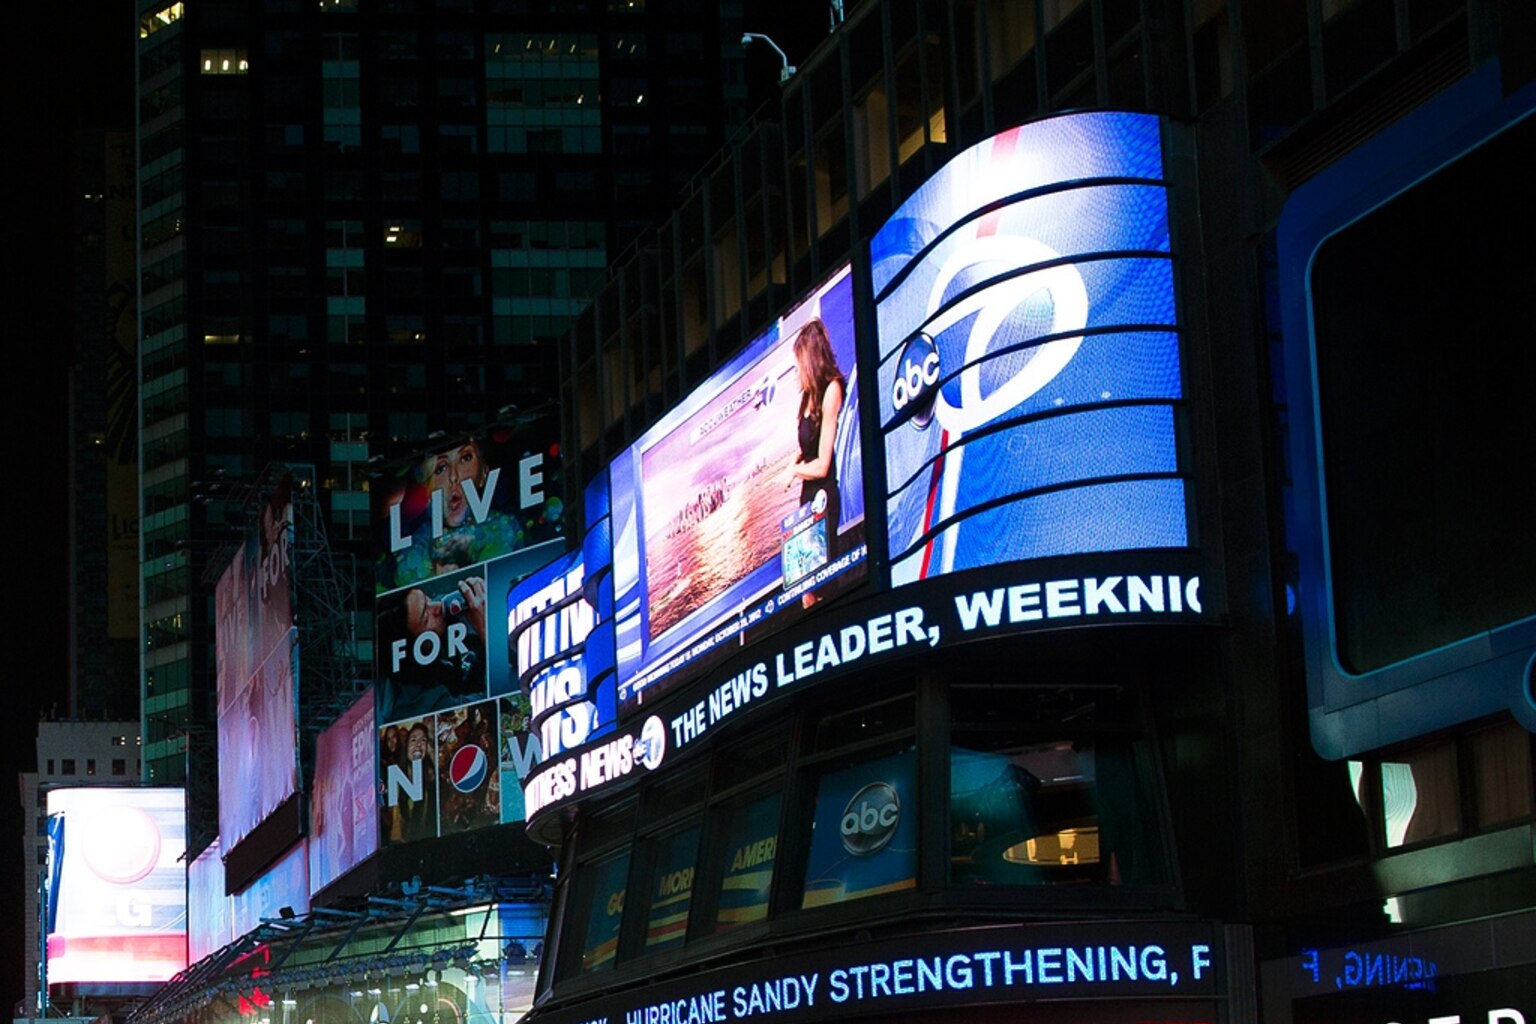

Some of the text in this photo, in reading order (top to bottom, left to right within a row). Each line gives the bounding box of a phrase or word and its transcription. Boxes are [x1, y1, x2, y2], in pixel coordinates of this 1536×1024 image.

[893, 352, 939, 411] abc
[390, 452, 545, 553] LIVE
[391, 621, 469, 673] FOR
[581, 735, 634, 791] NEWS
[671, 712, 706, 749] THE
[709, 662, 768, 730] NEWS
[777, 606, 940, 688] LEADER,
[841, 802, 899, 836] abc
[733, 973, 819, 1018] SANDY
[829, 944, 1179, 1003] STRENGTHENING,
